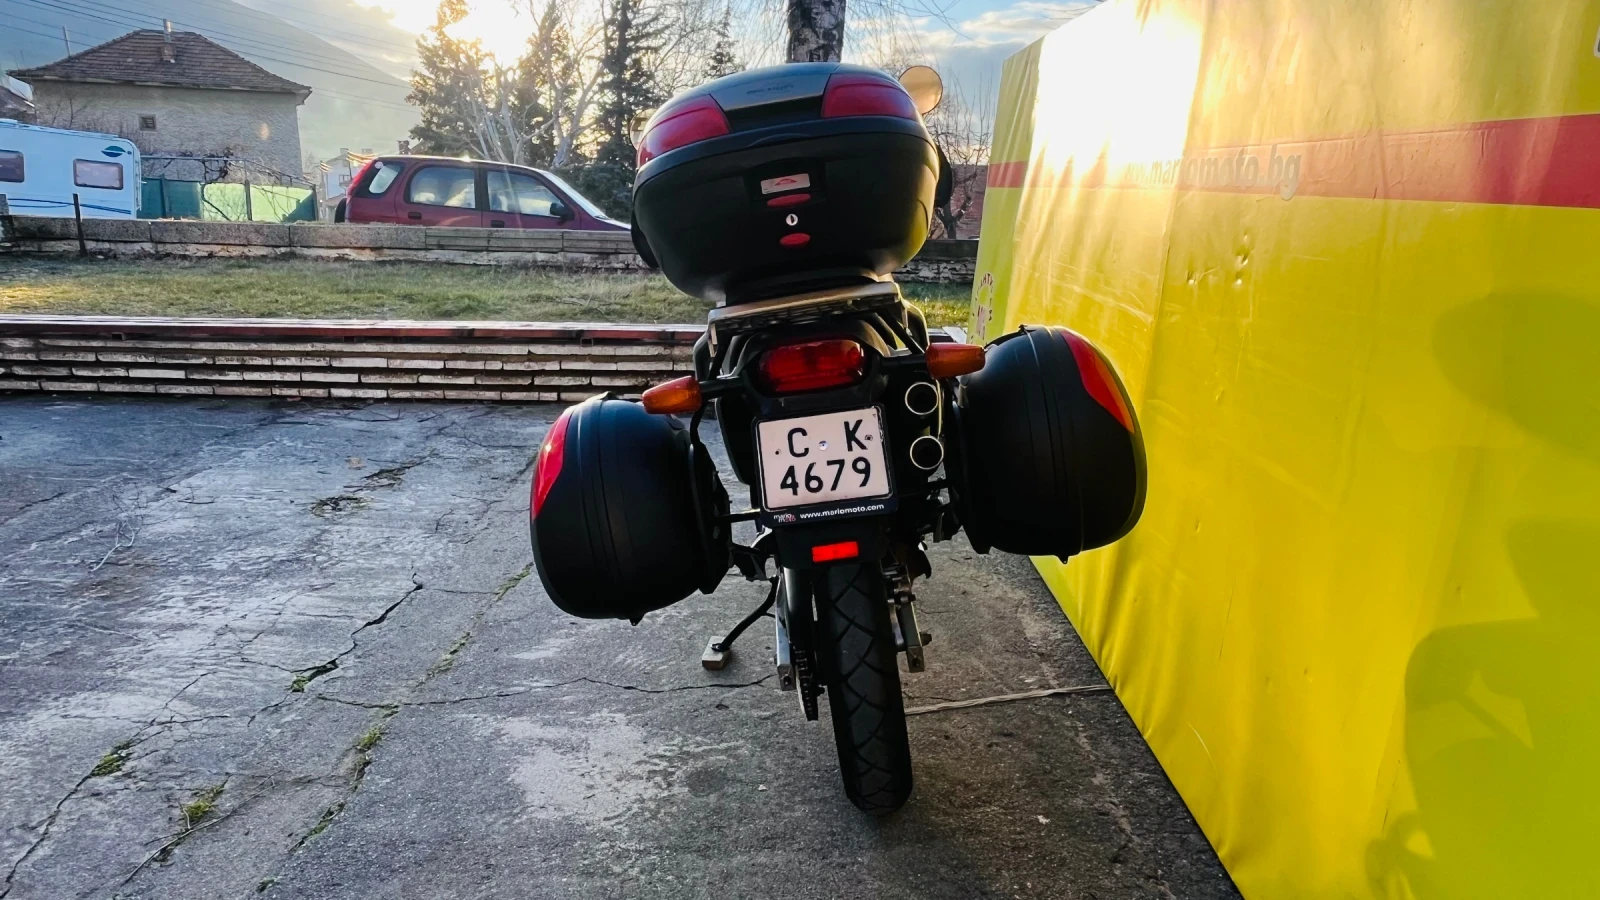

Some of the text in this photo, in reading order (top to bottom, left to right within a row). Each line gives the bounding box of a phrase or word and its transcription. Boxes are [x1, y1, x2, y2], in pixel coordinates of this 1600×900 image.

[1120, 144, 1302, 201] ww.mariomoto.bg
[787, 419, 868, 458] C K
[780, 456, 871, 496] 4679
[800, 504, 885, 519] www.mariomoto.com
